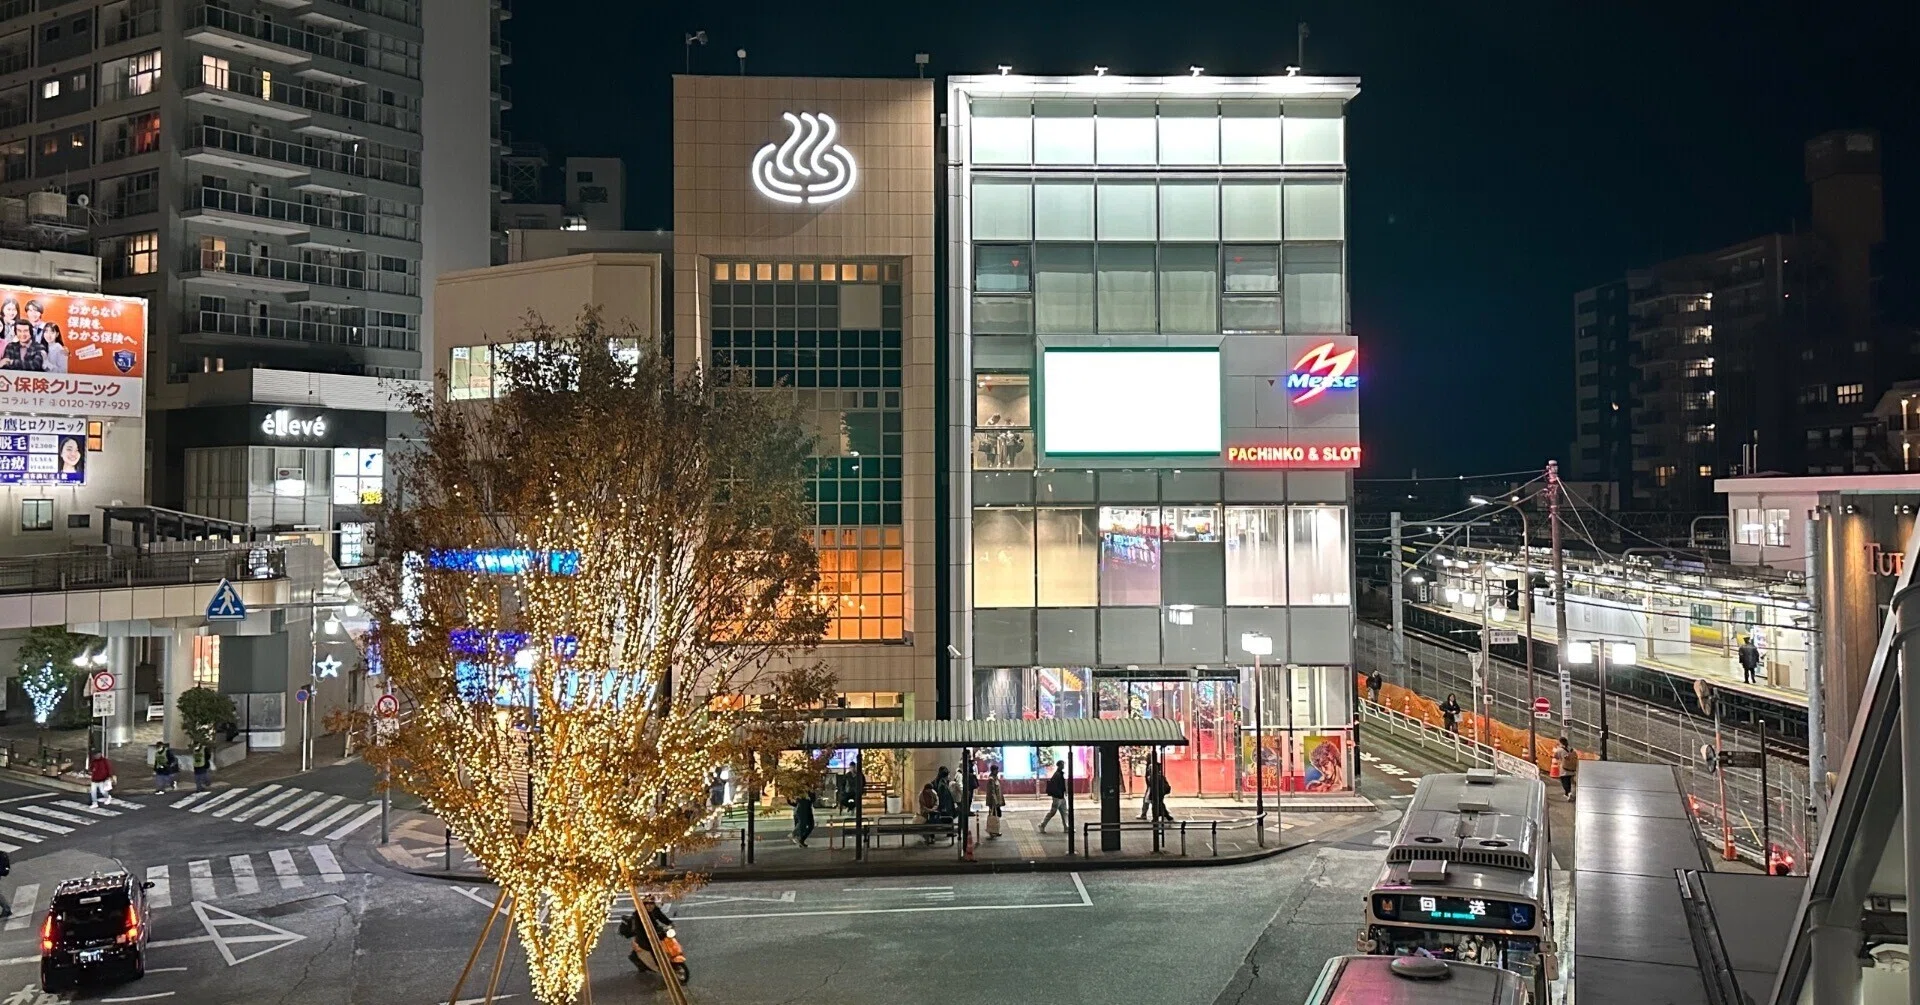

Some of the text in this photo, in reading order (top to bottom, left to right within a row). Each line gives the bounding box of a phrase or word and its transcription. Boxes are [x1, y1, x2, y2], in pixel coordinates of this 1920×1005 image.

[68, 305, 121, 318] わからない
[68, 316, 104, 330] 保険を、
[68, 329, 138, 345] わかる保険へ。
[14, 376, 121, 397] 保険クリニック
[1, 397, 130, 410] コラル 1F 0120-797-929
[0, 418, 84, 432] 鷹ヒロクリニック
[1308, 447, 1319, 461] &
[1323, 447, 1361, 461] SLOT
